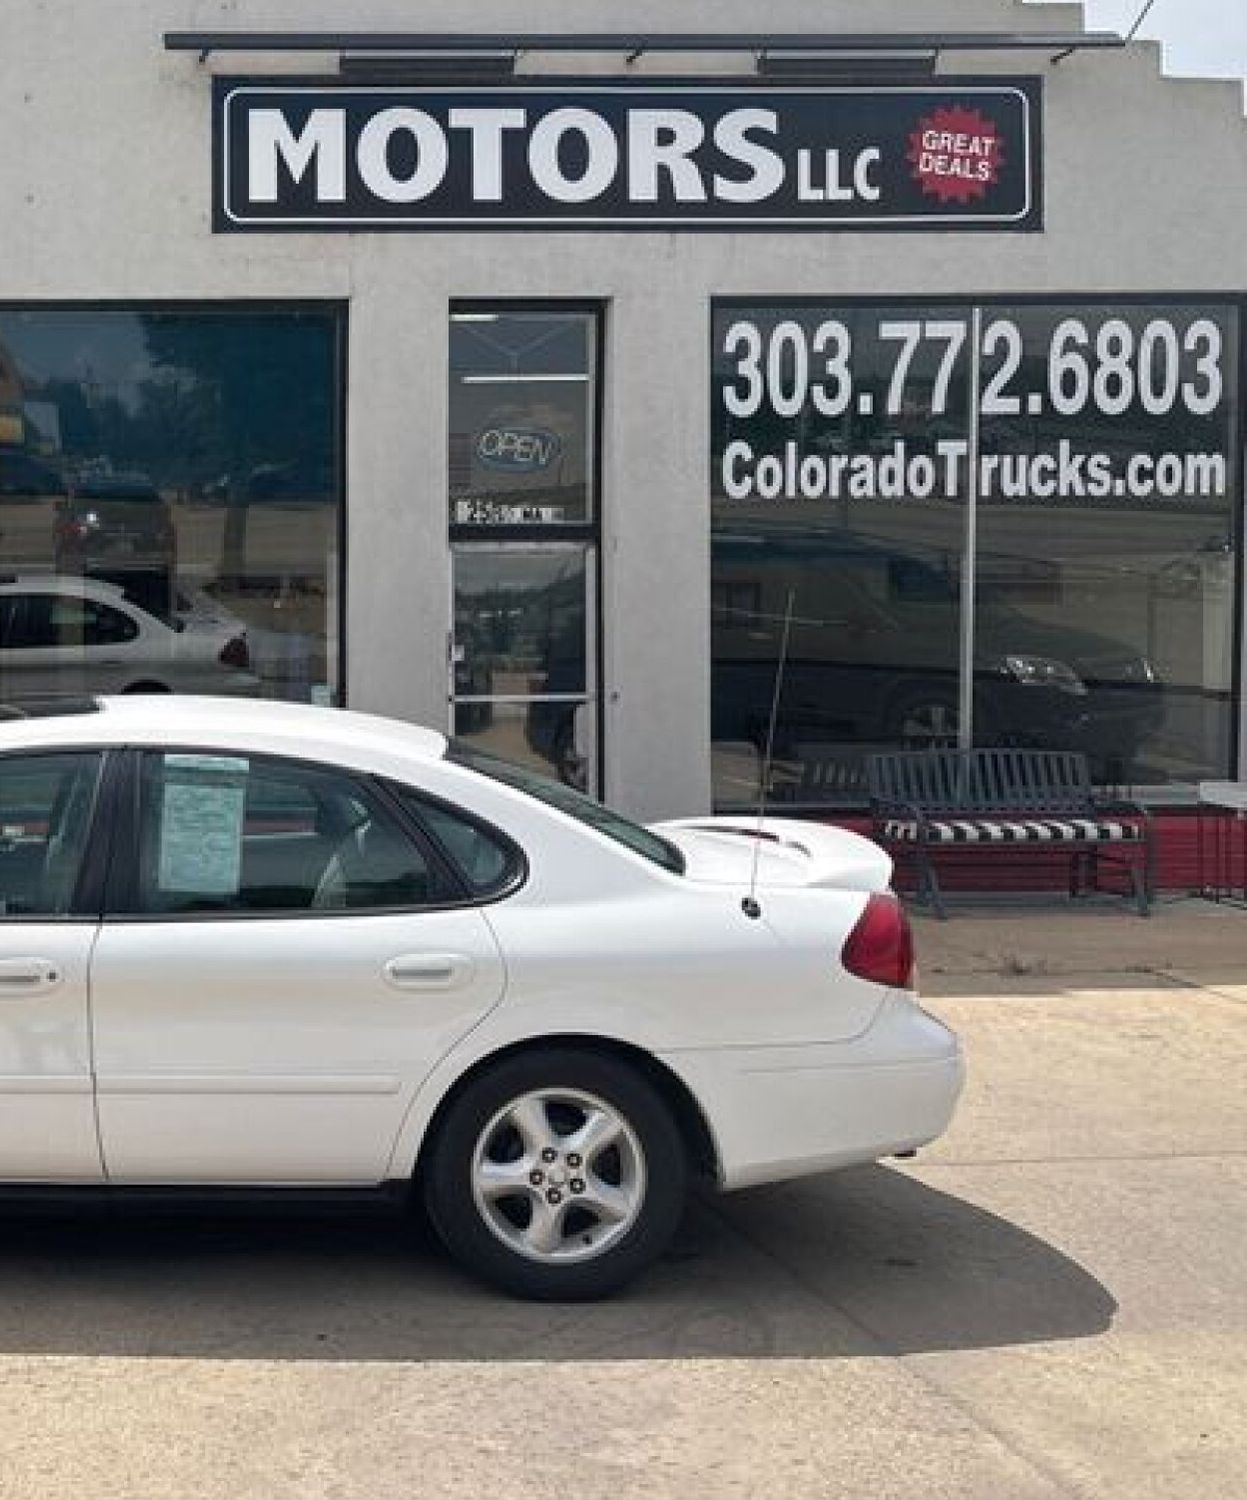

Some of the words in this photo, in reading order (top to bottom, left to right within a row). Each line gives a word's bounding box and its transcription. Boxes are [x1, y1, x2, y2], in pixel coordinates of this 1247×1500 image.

[247, 107, 787, 203] MOTORS
[797, 147, 881, 201] LLC
[919, 152, 990, 181] DEALS
[922, 130, 995, 156] GREAT
[721, 319, 1225, 418] 303.772.6803
[480, 429, 553, 465] OPEN
[721, 438, 1227, 500] ColoradoTrucks.com
